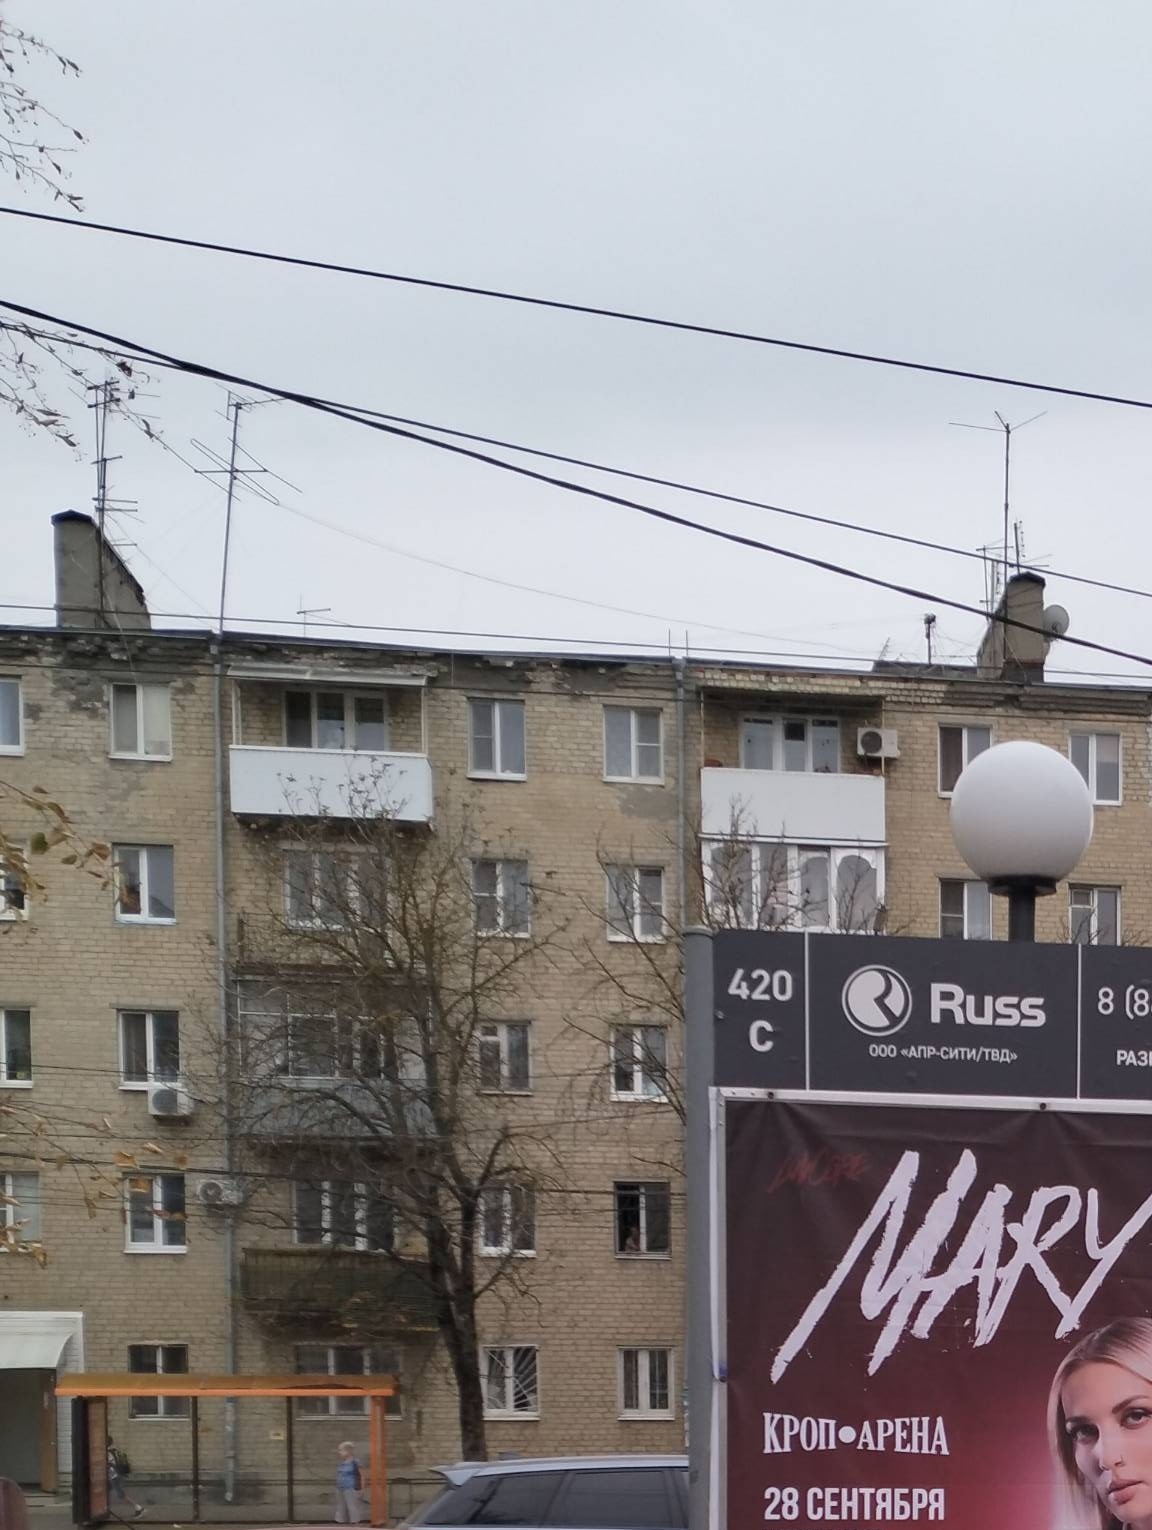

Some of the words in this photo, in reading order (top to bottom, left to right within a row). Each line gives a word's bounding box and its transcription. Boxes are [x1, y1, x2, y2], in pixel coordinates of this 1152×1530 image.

[728, 968, 793, 1002] 420
[1097, 987, 1115, 1014] 8
[930, 983, 1046, 1028] Russ
[869, 1043, 897, 1059] ООО
[900, 1044, 1018, 1064] «АПР-СИТИ/ТВД»
[763, 1487, 800, 1522] 28
[807, 1487, 945, 1521] СЕНТЯБРЯ
